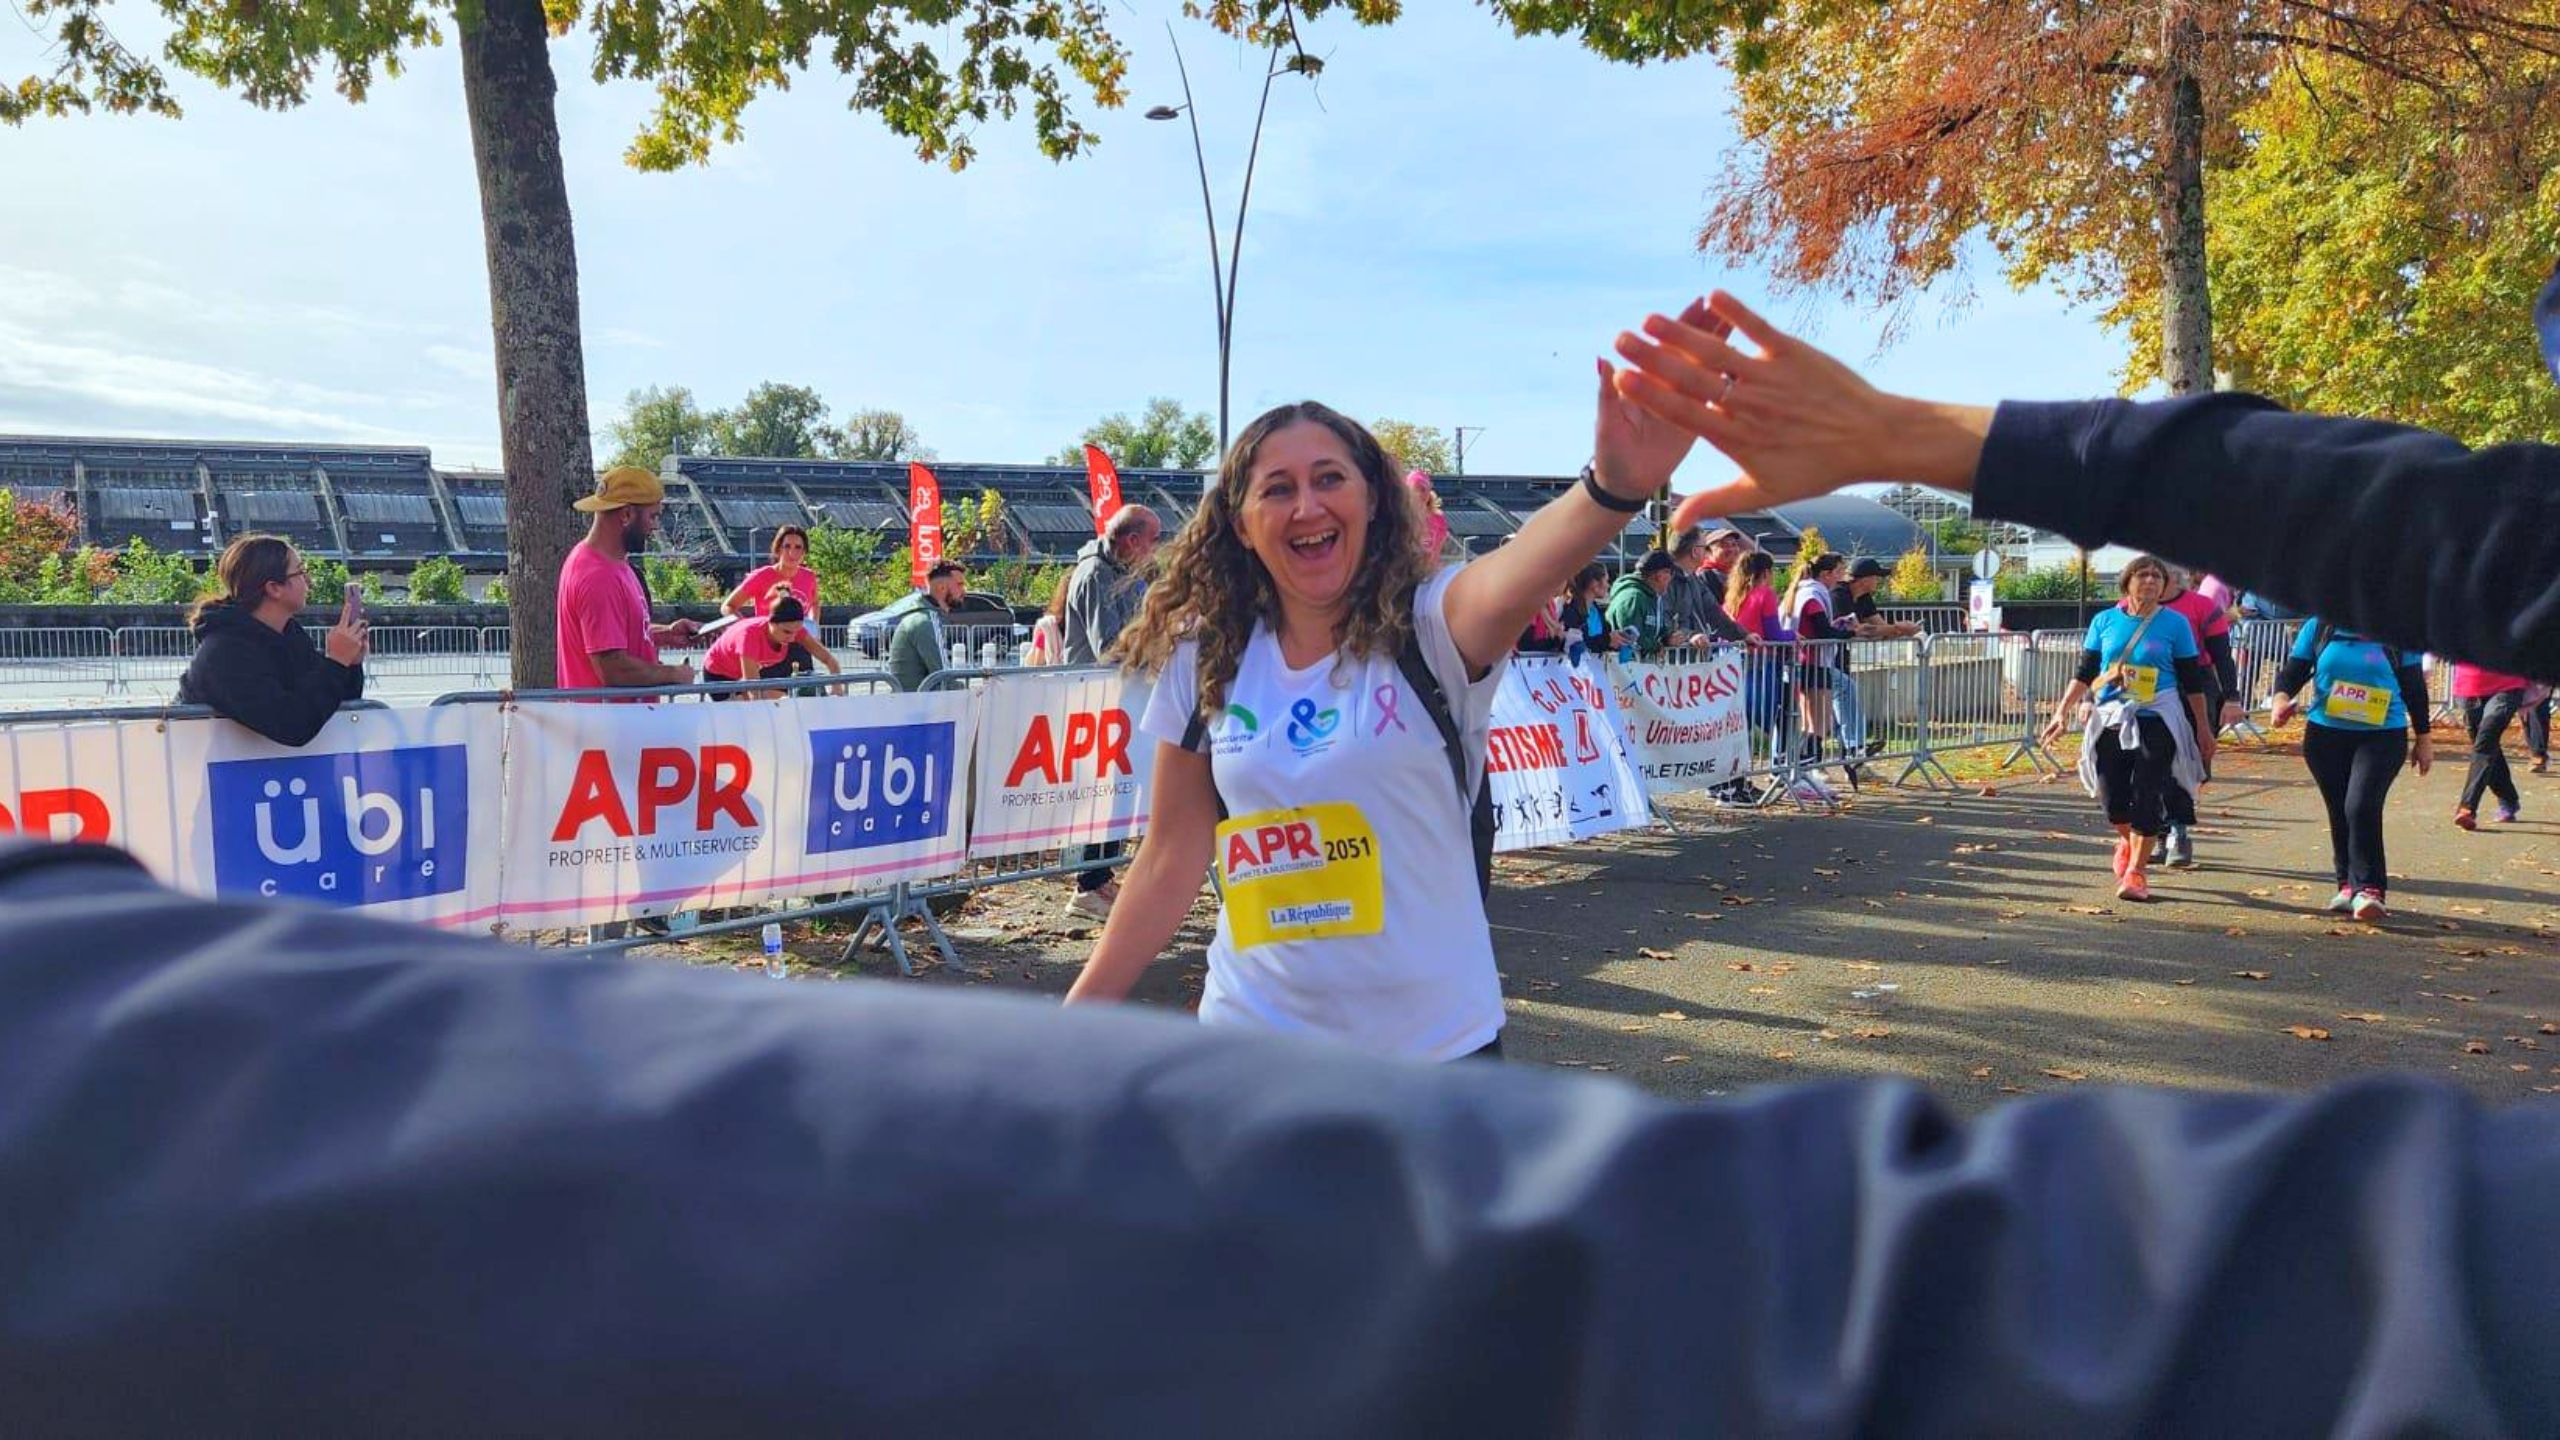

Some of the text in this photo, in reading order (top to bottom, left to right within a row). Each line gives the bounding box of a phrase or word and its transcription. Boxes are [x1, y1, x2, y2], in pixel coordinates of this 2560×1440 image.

[2333, 685, 2366, 701] APR
[1003, 708, 1133, 787] APR
[1638, 758, 1716, 780] THLETISME
[551, 744, 759, 842] APR
[1002, 791, 1055, 807] PROPRETE
[549, 834, 759, 868] PROPRETE & MULTISERVICES
[1228, 822, 1321, 874] APR
[1325, 836, 1371, 861] 2051
[1271, 902, 1352, 924] La République
